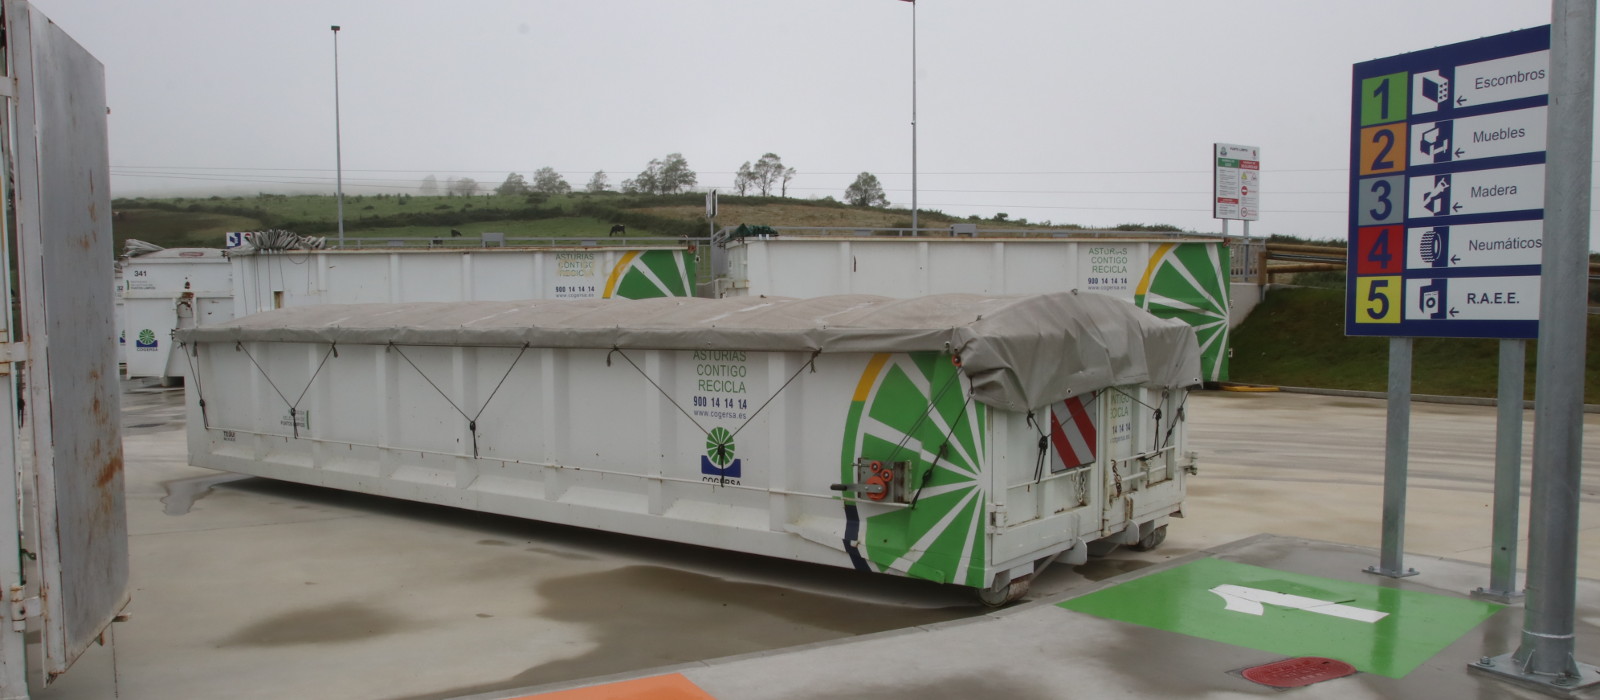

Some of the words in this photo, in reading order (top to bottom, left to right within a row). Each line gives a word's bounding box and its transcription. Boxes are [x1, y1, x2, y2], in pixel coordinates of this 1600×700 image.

[1373, 78, 1390, 121] 1
[1475, 69, 1545, 90] Escombros
[1372, 129, 1395, 170] 2
[1473, 127, 1526, 143] Muebles
[1370, 180, 1392, 220] 3
[1470, 184, 1517, 198] Madera
[555, 252, 595, 260] ASTURIAS
[1367, 229, 1392, 269] 4
[1469, 237, 1542, 251] Neumáticos
[1091, 256, 1128, 264] CONTIGO
[1092, 265, 1127, 273] RECICLA
[1366, 279, 1389, 320] 5
[1467, 292, 1520, 304] R.A.E.E.
[692, 349, 747, 362] ASTURIAS
[696, 364, 747, 377] CONTIGO
[698, 379, 746, 393] RECICLA
[693, 396, 707, 407] 900
[711, 397, 720, 407] 14
[725, 398, 733, 408] 14
[738, 399, 747, 410] 14
[694, 409, 746, 420] www.cogersa.es
[1208, 583, 1390, 624] 1
